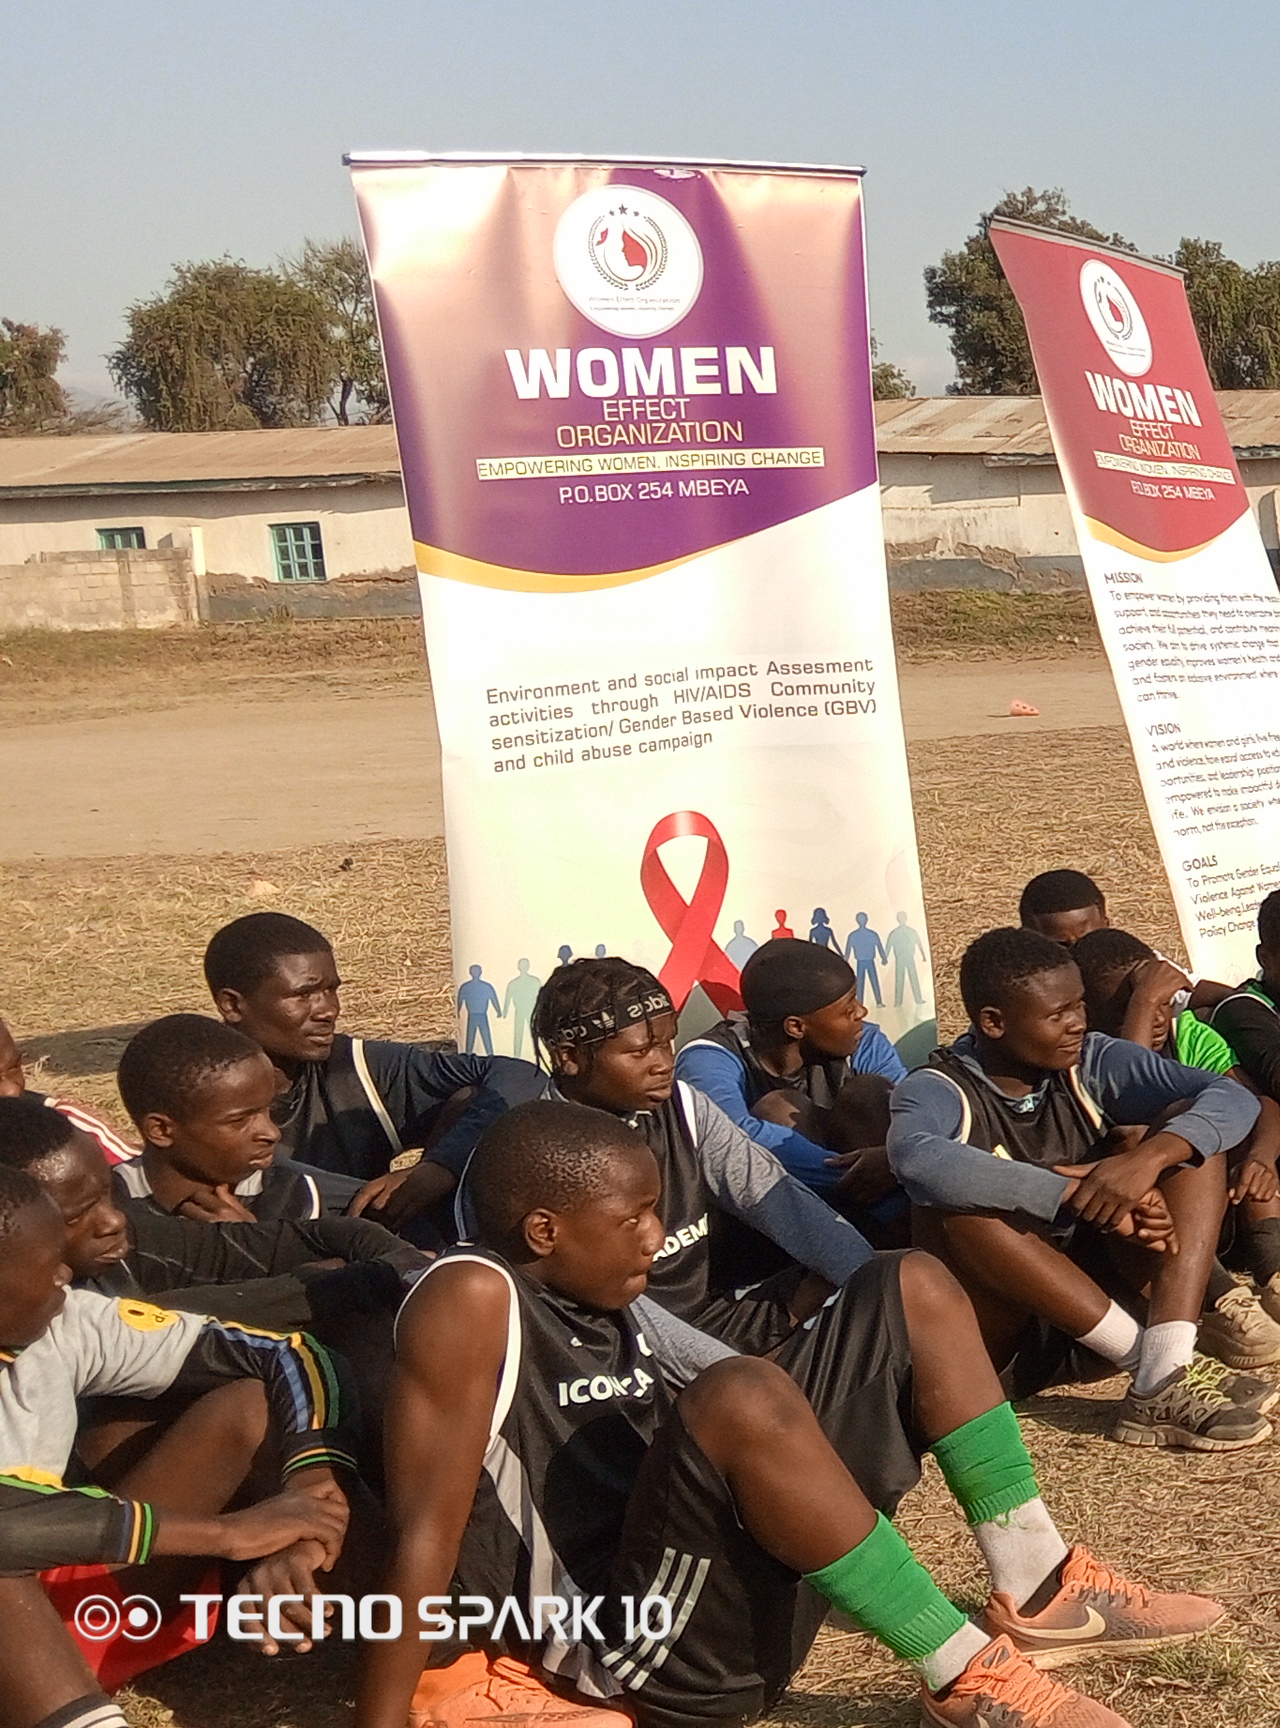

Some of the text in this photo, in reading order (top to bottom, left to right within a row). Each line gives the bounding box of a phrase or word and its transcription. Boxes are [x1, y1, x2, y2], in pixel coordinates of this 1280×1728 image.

[504, 346, 778, 400] WOMEN
[602, 397, 691, 422] EFFECT
[1084, 370, 1203, 428] WOMEN
[556, 420, 744, 449] ORGANIZATION
[1129, 419, 1175, 440] EFFECT
[1119, 433, 1201, 461] ORGANIZATION
[479, 459, 594, 478] EMPOWERING
[666, 452, 747, 469] INSPIRING
[752, 450, 823, 467] CHANGE
[638, 480, 675, 500] 254
[679, 478, 751, 498] MBEYA
[1162, 484, 1183, 499] 254
[1184, 486, 1216, 501] MBEYA
[1104, 572, 1144, 584] MISSION
[1109, 590, 1122, 601] To
[486, 658, 873, 705] Environment and social impact Assesment
[1132, 674, 1152, 686] and
[489, 678, 876, 728] activities through HIV/AIDS Community
[491, 699, 877, 751] sensitization/ Gender Based Violence (GBV)
[1145, 722, 1182, 737] VISION
[493, 731, 714, 774] and child abuse campaign
[1182, 854, 1218, 872] GOALS
[1186, 876, 1200, 889] To
[1190, 891, 1229, 905] Violence
[1199, 917, 1256, 939] Policy Change
